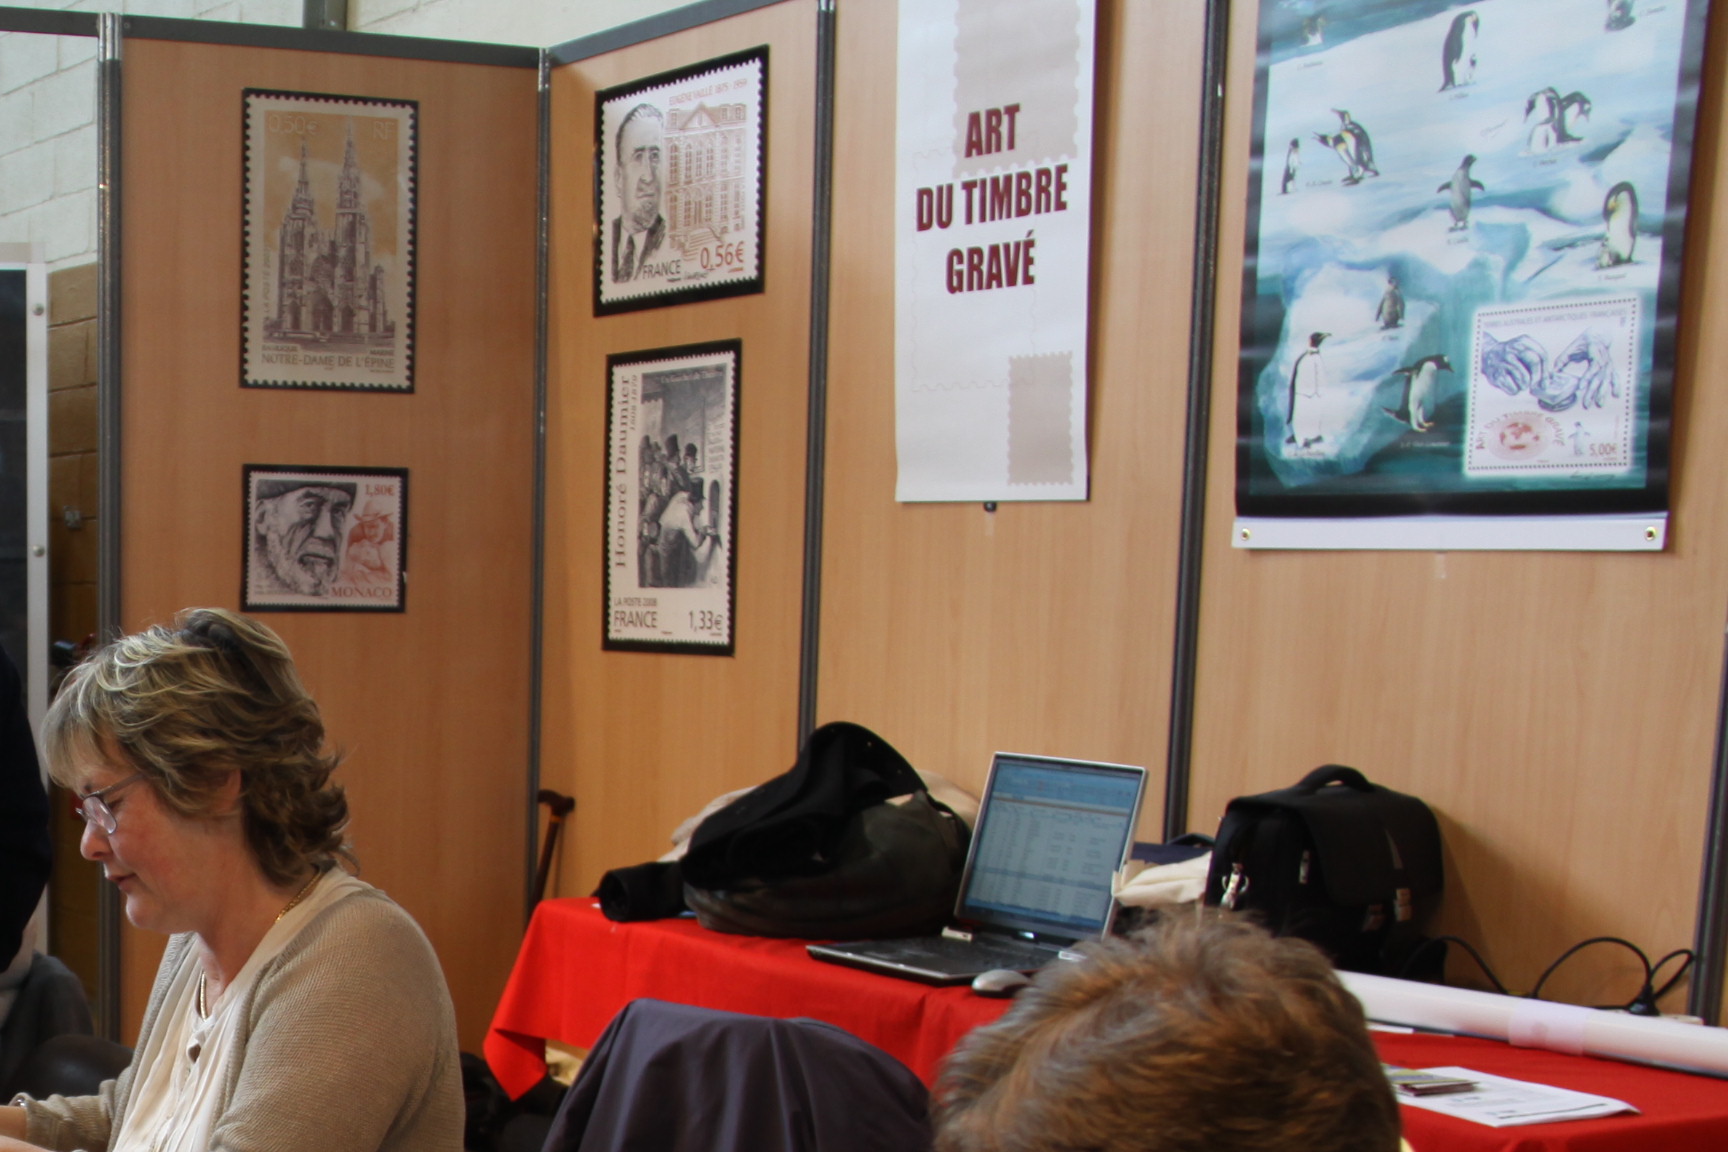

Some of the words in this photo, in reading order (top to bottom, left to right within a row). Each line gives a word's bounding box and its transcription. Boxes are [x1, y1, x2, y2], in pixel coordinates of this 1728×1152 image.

[373, 120, 396, 140] RF
[964, 103, 1020, 158] ART
[916, 183, 954, 232] DU
[961, 163, 1068, 226] TIMBRE
[642, 259, 681, 280] FRANCE
[700, 241, 745, 270] 0,56€
[946, 229, 1036, 295] GRAVÉ
[261, 353, 335, 366] NOTRE-DAME
[338, 356, 353, 367] DE
[615, 375, 629, 475] Daumier
[365, 483, 395, 497] 1,80€
[614, 482, 628, 568] Honoré
[331, 586, 393, 599] MONACO
[613, 610, 658, 629] FRANCE
[688, 609, 724, 632] 1,33€
